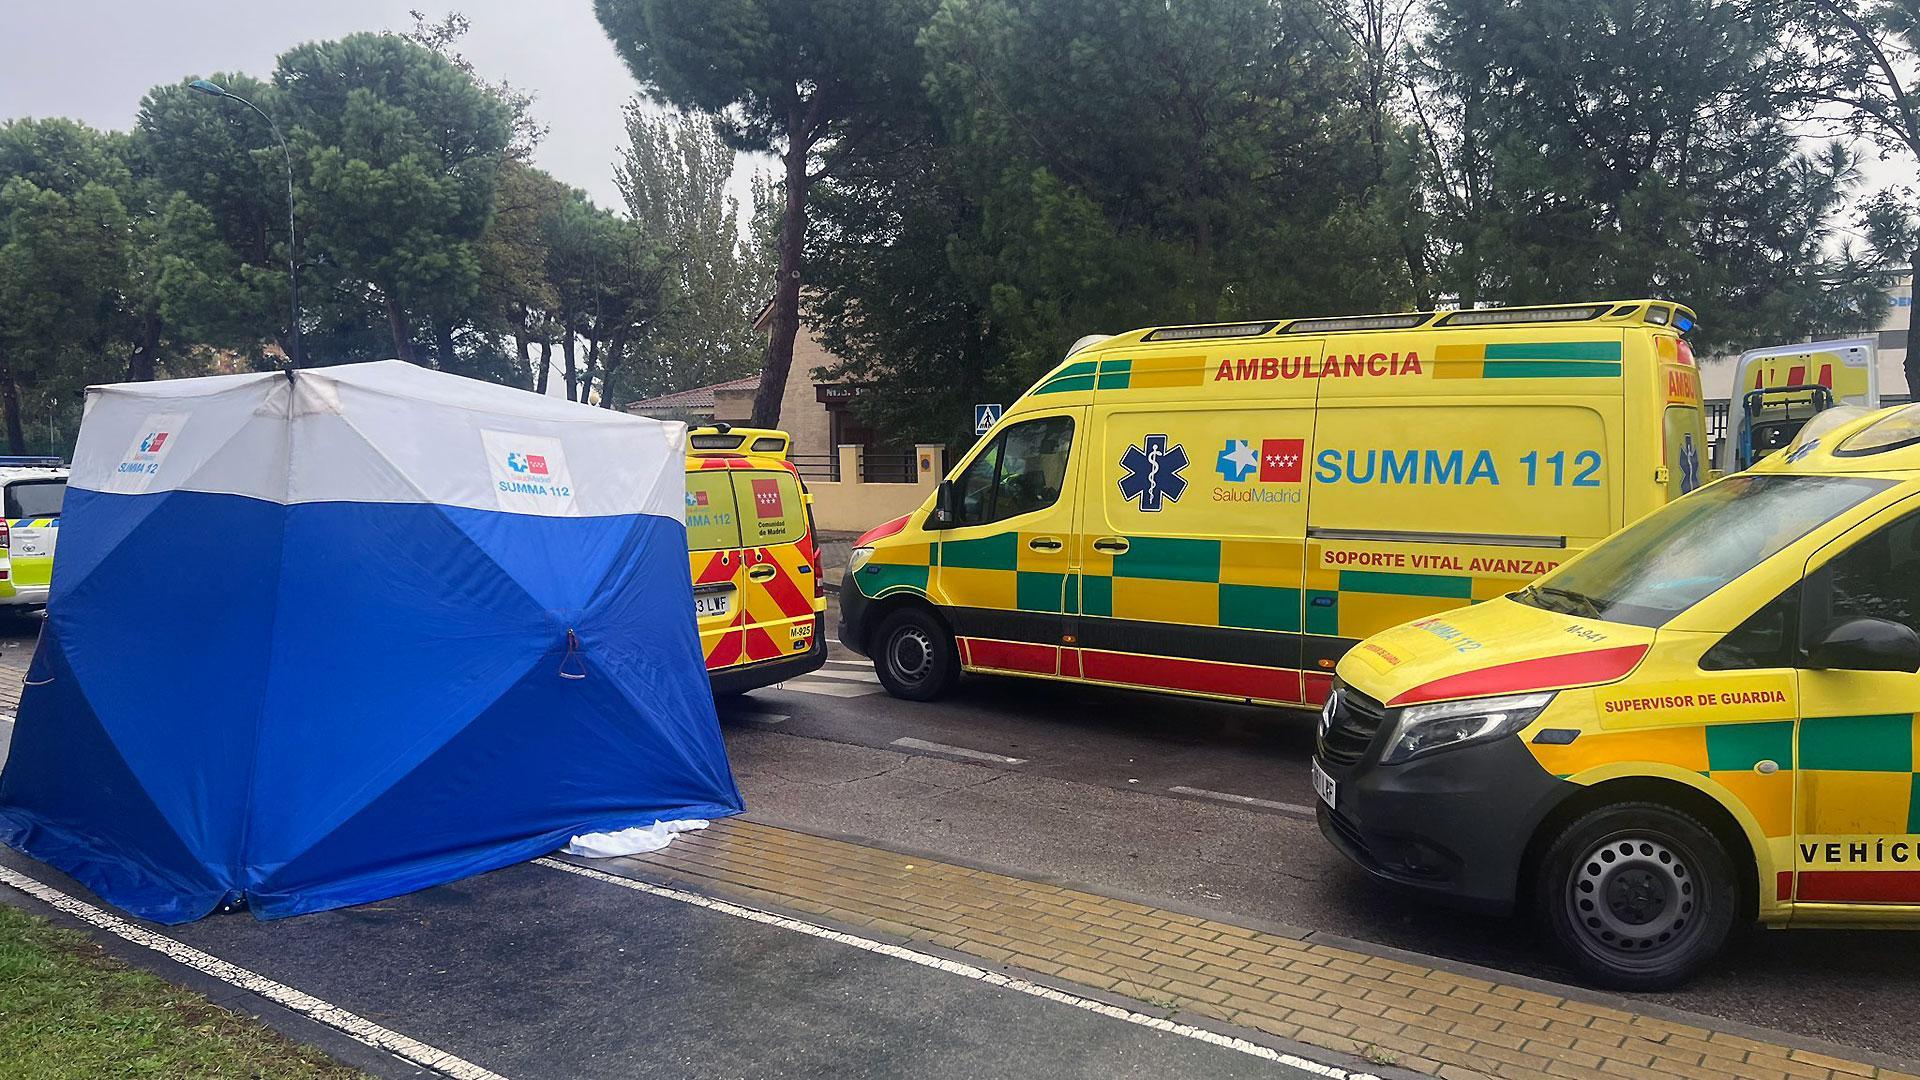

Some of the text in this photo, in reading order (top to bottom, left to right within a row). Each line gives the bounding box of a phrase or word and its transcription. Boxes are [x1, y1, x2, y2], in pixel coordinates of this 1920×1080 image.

[1214, 351, 1423, 381] AMBULANCIA
[1314, 449, 1602, 487] SUMMA 112
[499, 481, 570, 497] SUMMA 112
[1212, 487, 1301, 504] SaludMadrid
[713, 513, 732, 525] 112
[757, 520, 785, 529] Comunidad
[767, 527, 786, 536] Madrid
[1324, 550, 1405, 567] SOPORTE
[1411, 554, 1463, 571] VITAL
[706, 596, 727, 611] LWF
[790, 625, 811, 637] M-925
[1605, 690, 1786, 713] SUPERVISOR DE GUARDIA
[1799, 838, 1920, 863] VEHÍC
